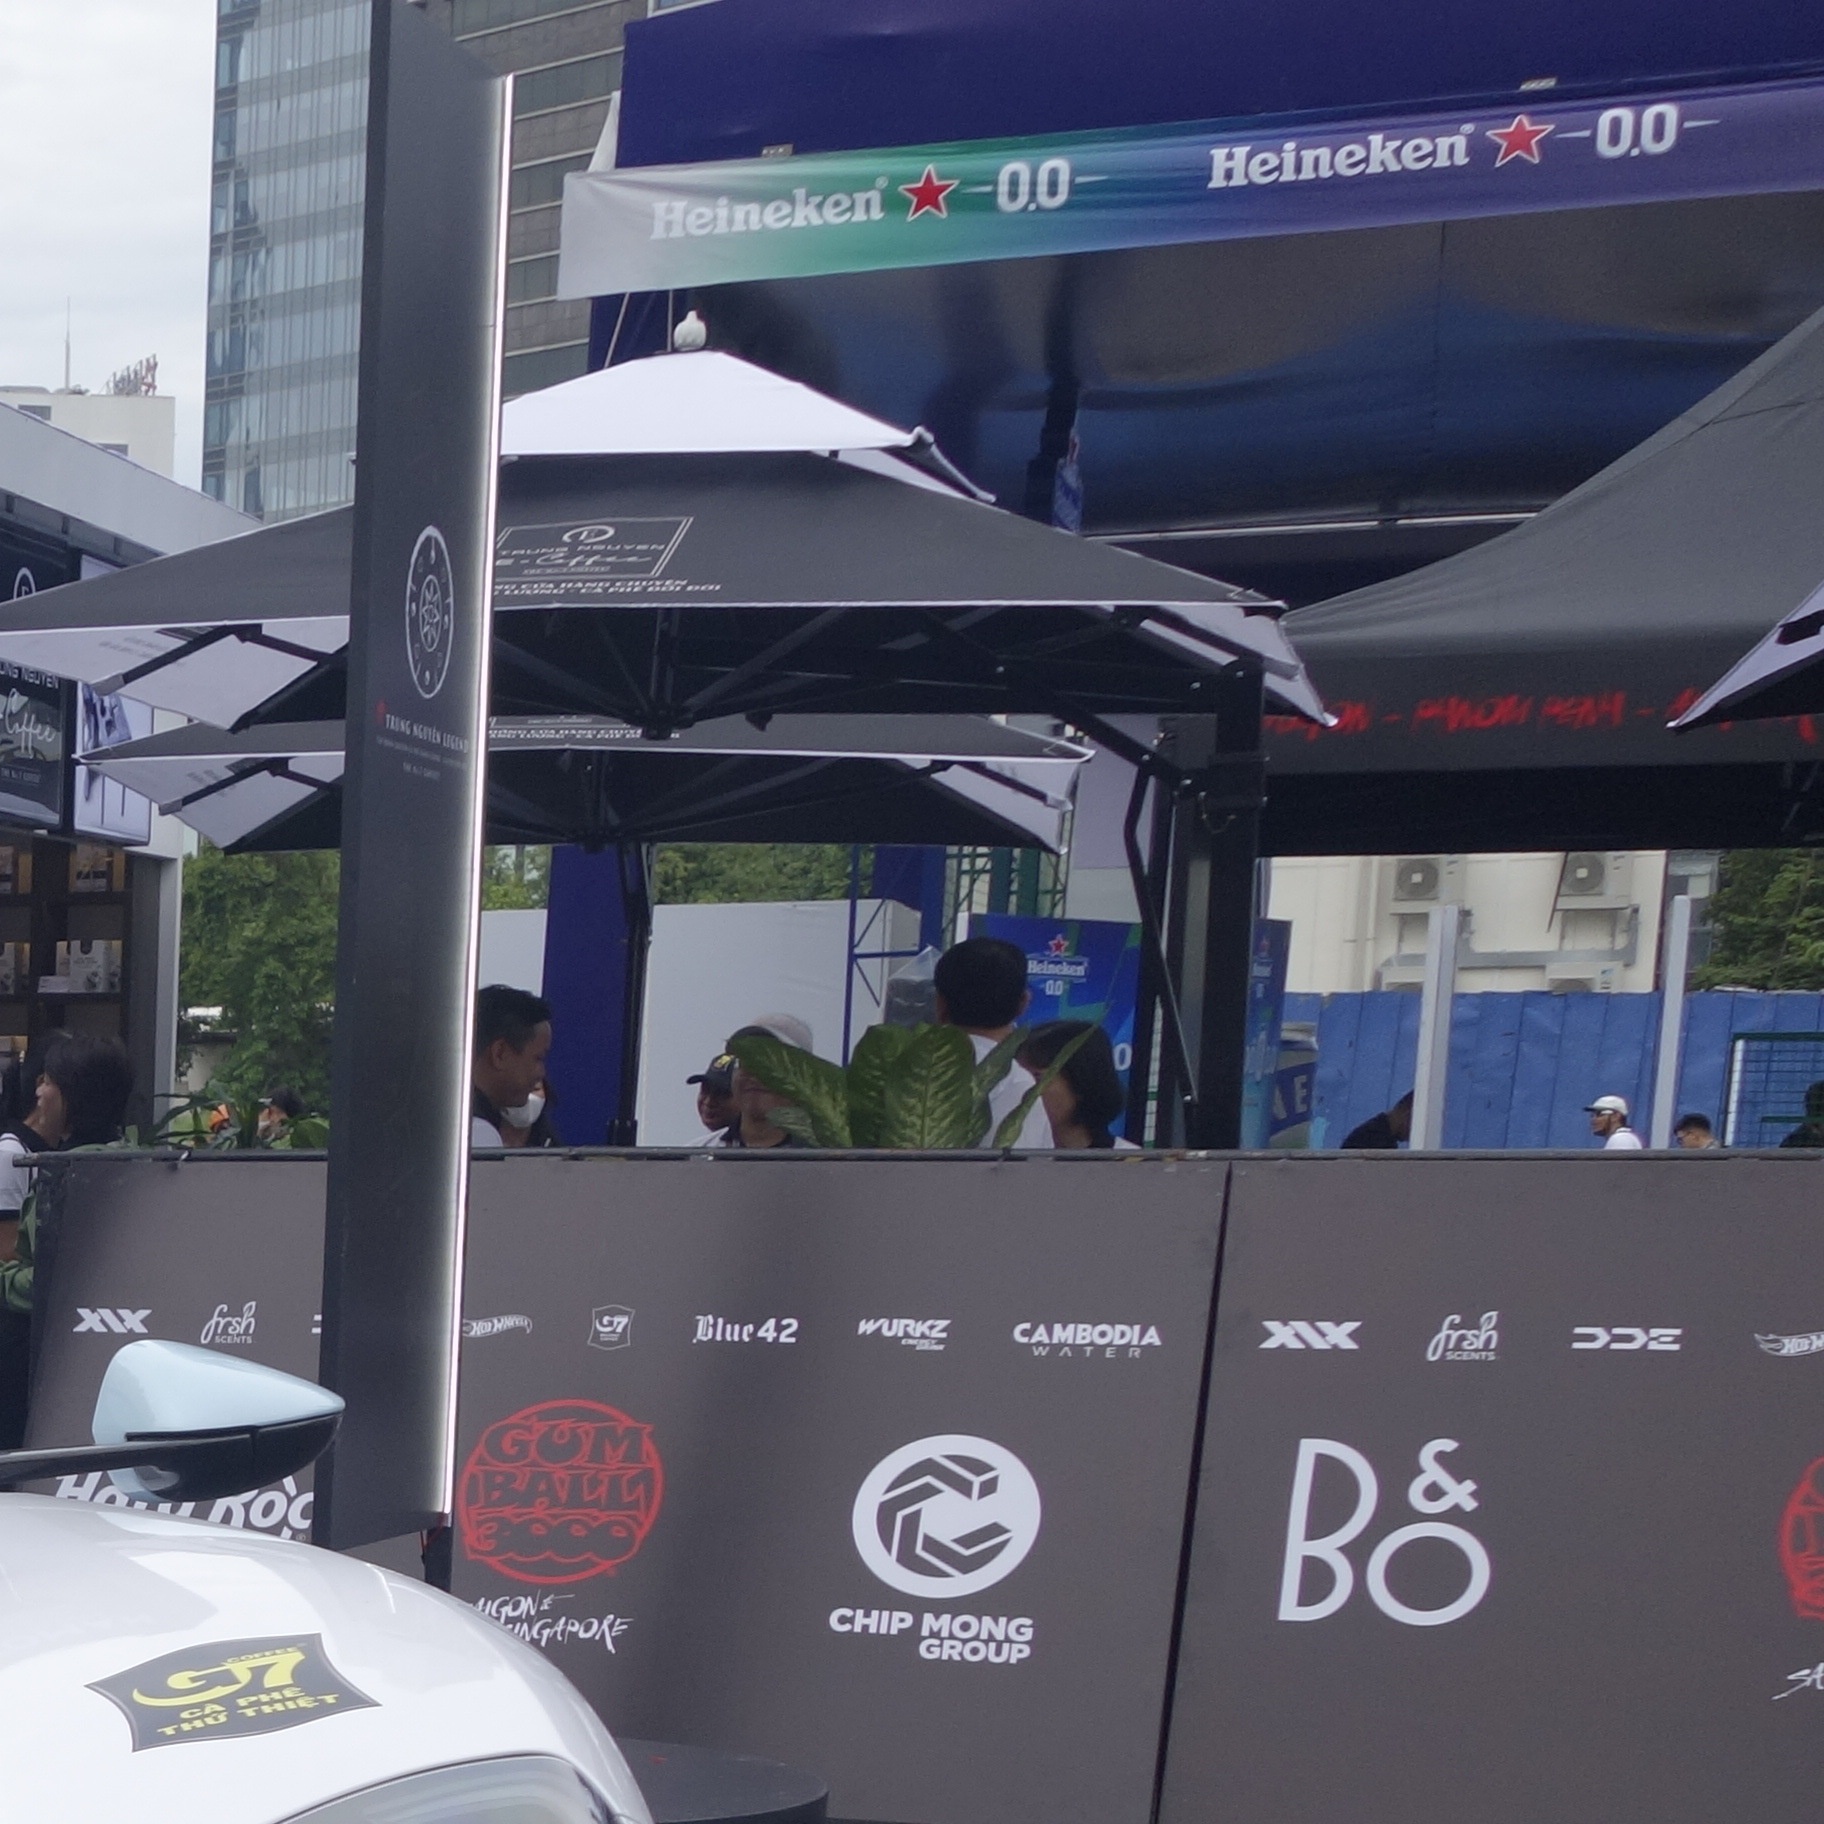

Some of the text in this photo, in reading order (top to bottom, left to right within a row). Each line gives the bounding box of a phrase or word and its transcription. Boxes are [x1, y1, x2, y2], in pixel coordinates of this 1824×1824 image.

[1207, 129, 1470, 191] Heineken
[650, 186, 884, 241] Heineken
[1026, 959, 1086, 977] Heineken
[214, 1335, 253, 1344] SCENTS
[693, 1313, 799, 1345] Blue 42
[856, 1317, 952, 1339] WURKZ
[1012, 1321, 1163, 1347] CAMBODIA
[1032, 1345, 1142, 1359] WATER
[1445, 1350, 1497, 1361] SCENTS
[828, 1606, 1034, 1643] CHIP MONG
[918, 1638, 1031, 1665] GROUP
[132, 1651, 306, 1708] G7
[179, 1686, 306, 1721] CÀ PHÊ
